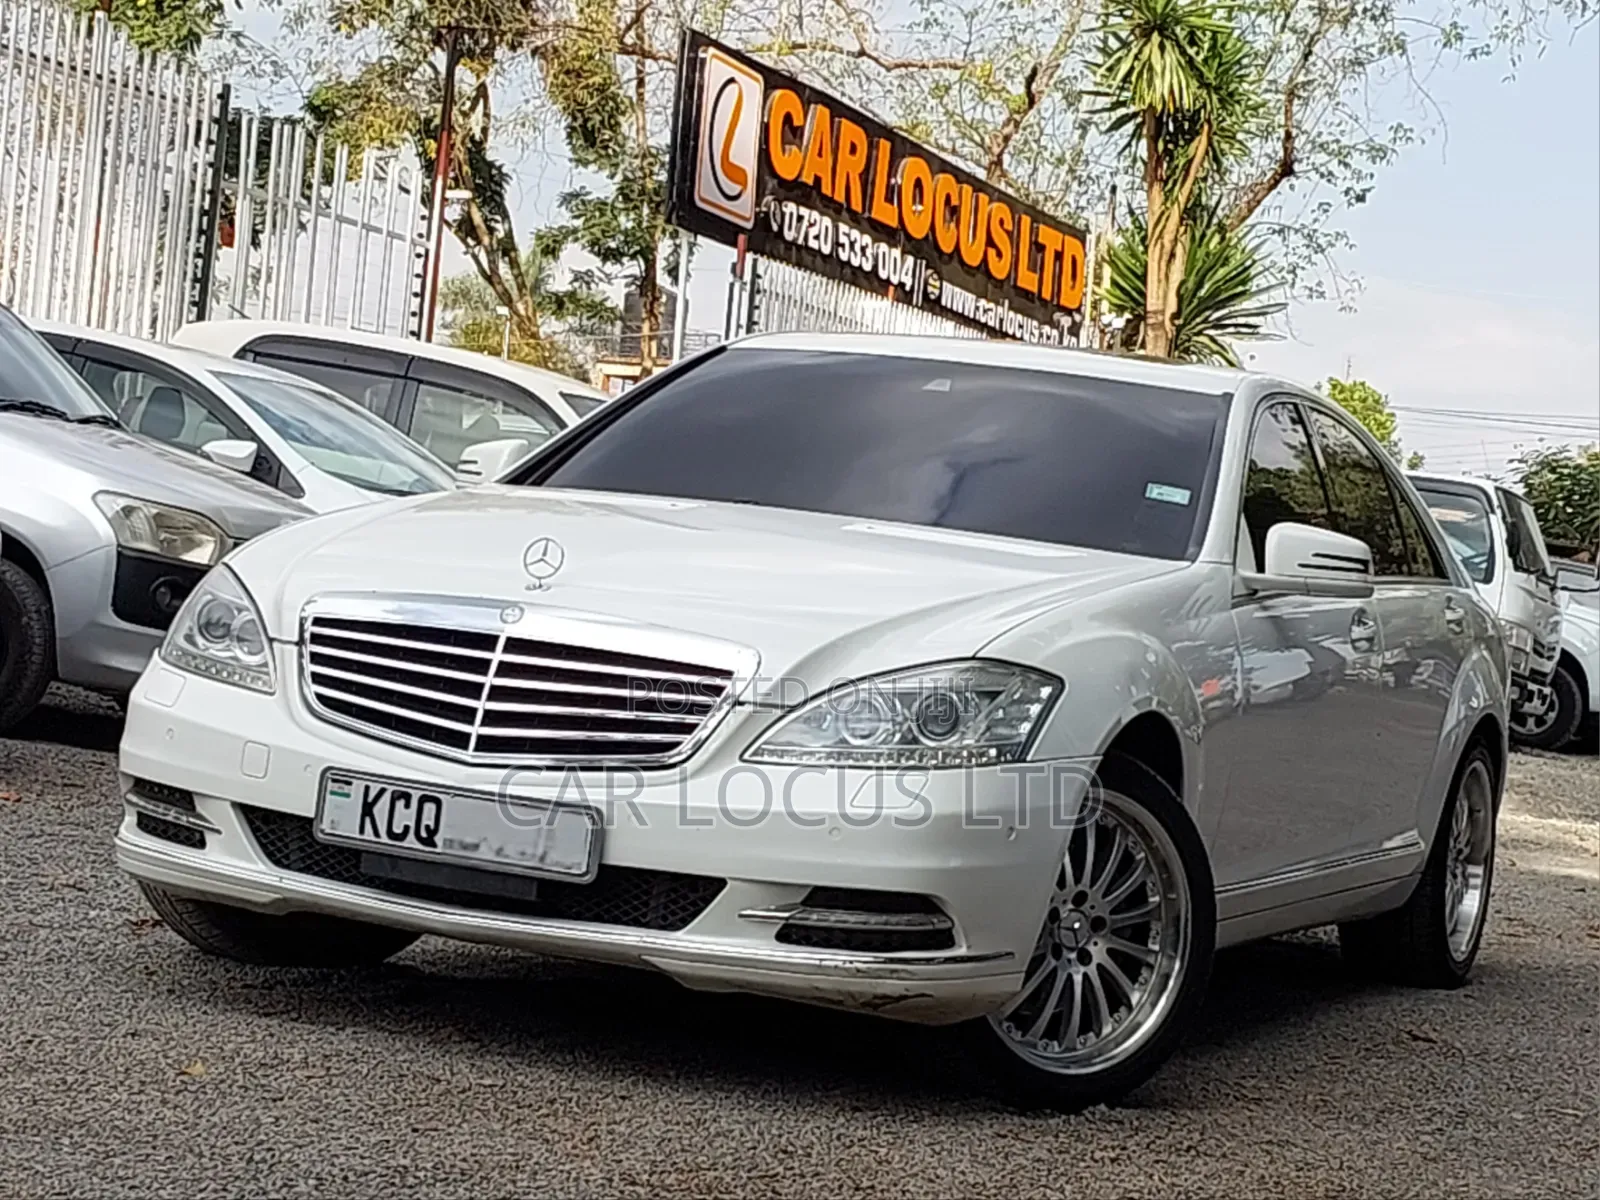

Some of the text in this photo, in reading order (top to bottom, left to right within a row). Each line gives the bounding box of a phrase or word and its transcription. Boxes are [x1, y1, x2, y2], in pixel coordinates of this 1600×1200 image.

[766, 88, 1086, 309] CAR LOCUS LTD
[782, 200, 832, 255] 0720
[837, 222, 873, 272] 533
[876, 242, 915, 292] 004
[358, 783, 444, 849] KCQ
